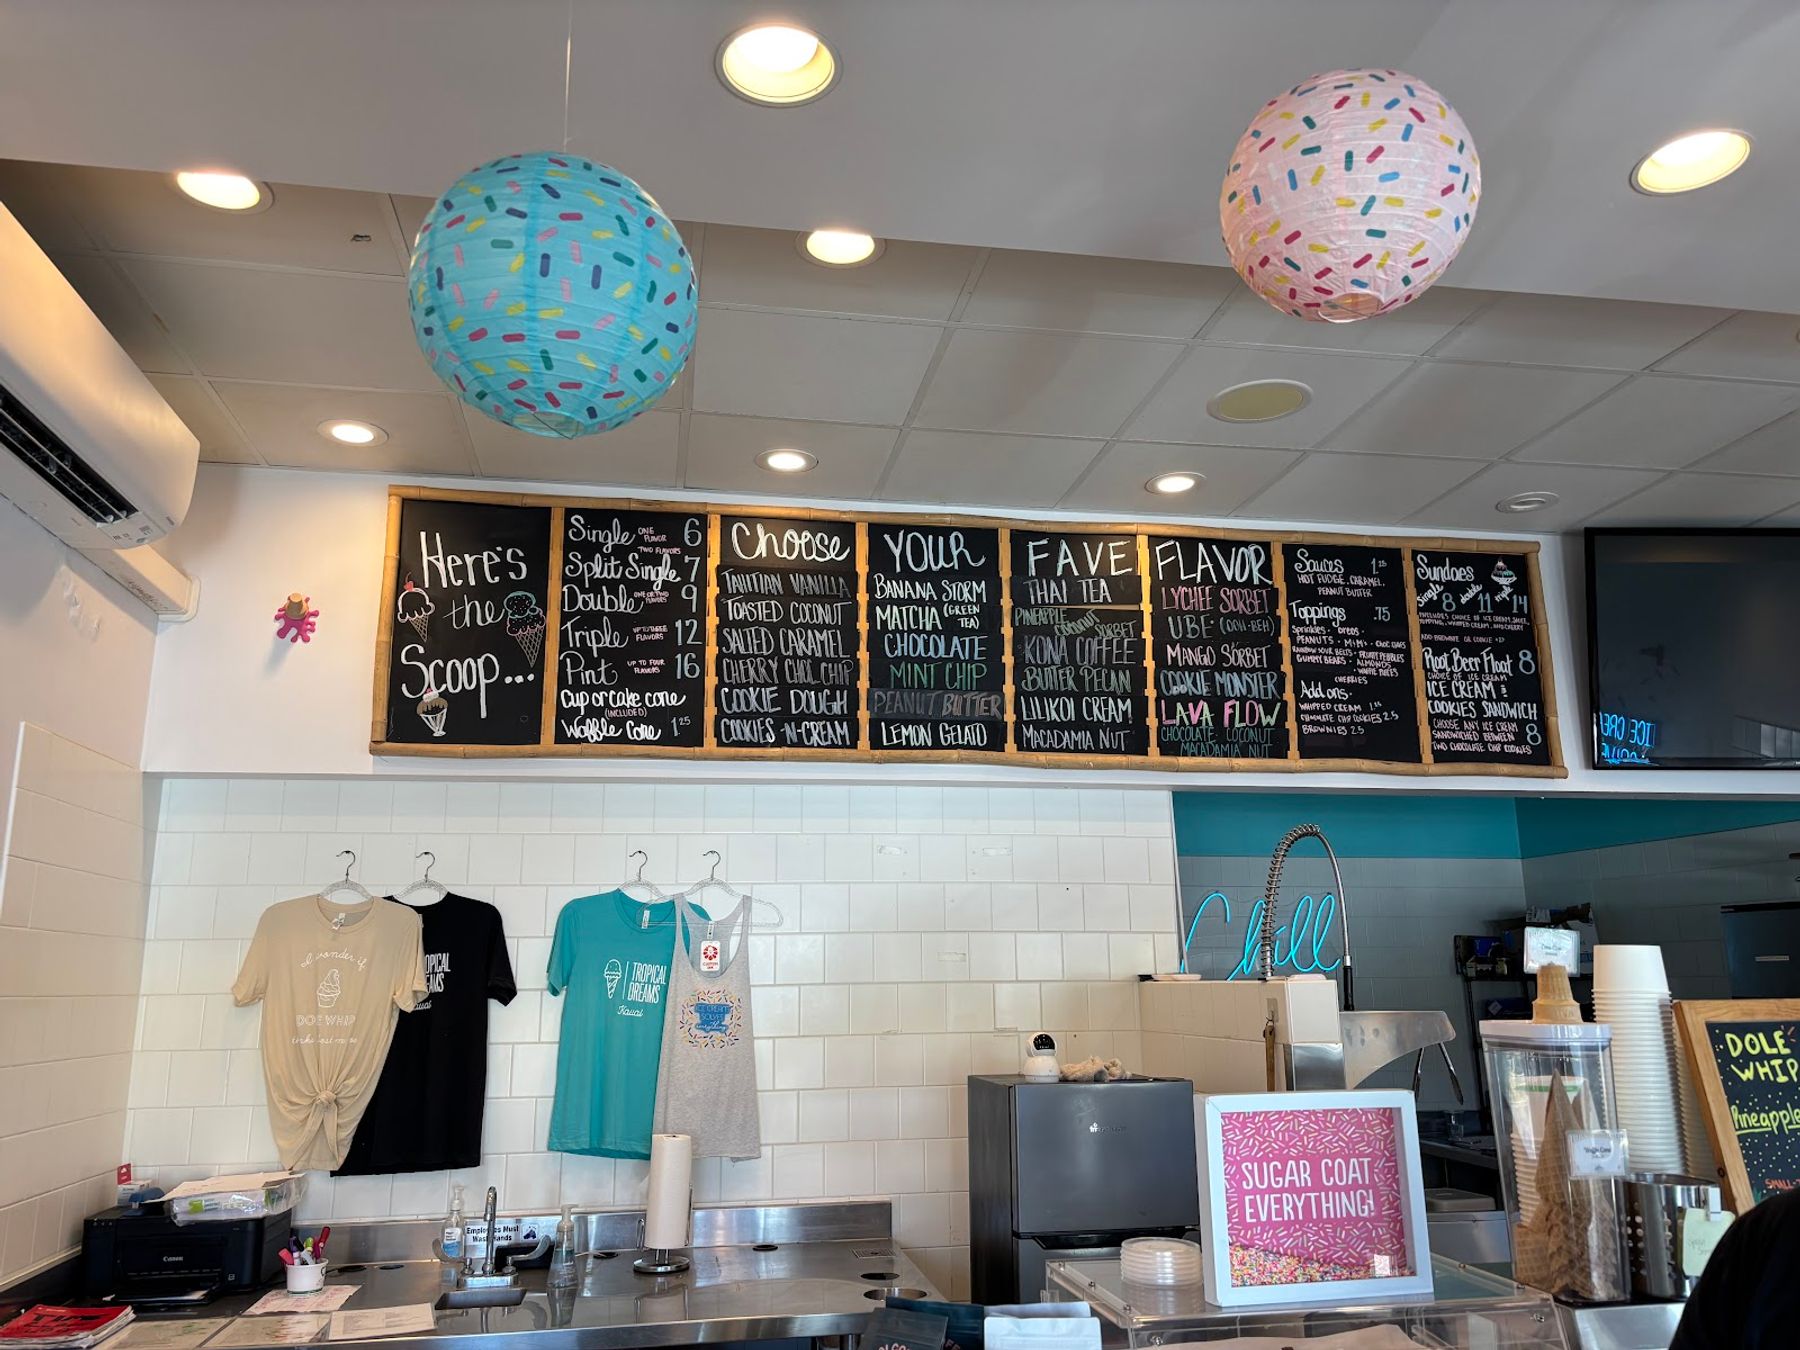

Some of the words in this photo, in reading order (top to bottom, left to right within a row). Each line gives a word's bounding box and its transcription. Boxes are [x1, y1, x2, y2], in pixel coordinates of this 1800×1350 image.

[568, 515, 635, 553] Single
[684, 518, 702, 546] 6
[731, 522, 850, 562] Choose
[420, 531, 527, 588] Here's
[884, 529, 986, 573] YOUR
[1026, 538, 1132, 576] FAVE
[1155, 540, 1273, 585] FLAVOR
[1295, 548, 1344, 573] Sauces
[565, 552, 623, 588] Split
[625, 553, 681, 591] Single
[684, 555, 700, 582] 7
[1297, 573, 1314, 584] HOT
[1417, 554, 1474, 582] Sundaes
[721, 569, 784, 595] TAHITIAN
[790, 573, 851, 598] VANILLA
[873, 573, 937, 602] BANANA
[942, 580, 987, 603] STORM
[1023, 578, 1068, 605] THAI
[1077, 578, 1112, 604] TEA
[443, 594, 505, 629] the
[563, 584, 643, 612] Double
[681, 584, 697, 612] 9
[721, 595, 784, 622] TOASTED
[790, 602, 852, 625] COCONUT
[1161, 586, 1214, 612] LYCHEE
[1219, 587, 1272, 614] SORBET
[1442, 593, 1456, 612] 8
[1477, 593, 1493, 613] 11
[1512, 594, 1528, 614] 14
[876, 605, 942, 631] MATCHA
[944, 603, 980, 617] (GREEN
[959, 616, 980, 629] TEA)
[1015, 608, 1067, 626] PINEAPPLE
[1054, 608, 1100, 636] COCONUT
[1289, 600, 1346, 627] Toppings
[561, 616, 628, 657] Triple
[675, 619, 702, 645] 12
[722, 626, 774, 655] SALTED
[779, 628, 850, 658] CARAMEL
[1094, 620, 1137, 638] SORBET
[884, 632, 988, 660] CHOCOLATE
[1024, 635, 1069, 665] KONA
[1075, 637, 1137, 666] COFFEE
[1166, 643, 1216, 668] MANGO
[1222, 643, 1272, 668] SORBET
[560, 651, 618, 685] Pint
[675, 653, 701, 679] 16
[723, 656, 779, 685] CHERRY
[820, 659, 853, 686] CHIP
[1422, 647, 1450, 672] Root
[1451, 648, 1481, 673] Beer
[1480, 647, 1513, 676] Float
[1519, 650, 1535, 675] 8
[401, 644, 535, 719] Scoop...
[890, 662, 942, 689] MINT
[945, 662, 987, 690] CHIP
[1021, 666, 1078, 692] BUTTER
[1079, 666, 1131, 696] PECAN
[1160, 670, 1213, 697] COOKIE
[1214, 671, 1280, 699] MONSTER
[1300, 680, 1325, 699] Add
[1427, 680, 1449, 698] ICE
[1452, 680, 1497, 699] CREAM
[561, 689, 589, 714] Cup
[592, 692, 609, 707] or
[608, 688, 642, 708] cake
[645, 692, 686, 708] cone
[721, 687, 781, 715] COOKIE
[790, 688, 848, 715] DOUGH
[874, 690, 940, 714] PEANUT
[942, 691, 1002, 719] BUTTER
[1020, 696, 1075, 722] LILIKOI
[1083, 696, 1132, 724] CREAM
[1161, 699, 1215, 727] LAVA
[1223, 699, 1281, 728] FLOW
[1427, 700, 1476, 719] COOKIES
[1481, 700, 1537, 720] SANDWICH
[561, 716, 622, 743] Waffle
[721, 717, 776, 744] COOKIES
[881, 721, 932, 746] LEMON
[939, 722, 987, 746] GELATO
[1022, 724, 1094, 750] MACADAMIA
[1099, 728, 1130, 751] NUT
[1302, 724, 1347, 735] BROWNIES
[1525, 723, 1543, 745] 8
[1181, 742, 1241, 758] MACADAMIA
[1248, 744, 1270, 758] NUT
[632, 962, 667, 985] TROPICAL
[627, 982, 661, 1004] DREAMS
[1725, 1030, 1792, 1058] DOLE
[1730, 1057, 1799, 1083] WHIP
[1242, 1159, 1311, 1190] SUGAR
[1320, 1157, 1371, 1185] COAT
[1245, 1189, 1376, 1223] EVERYTHING!
